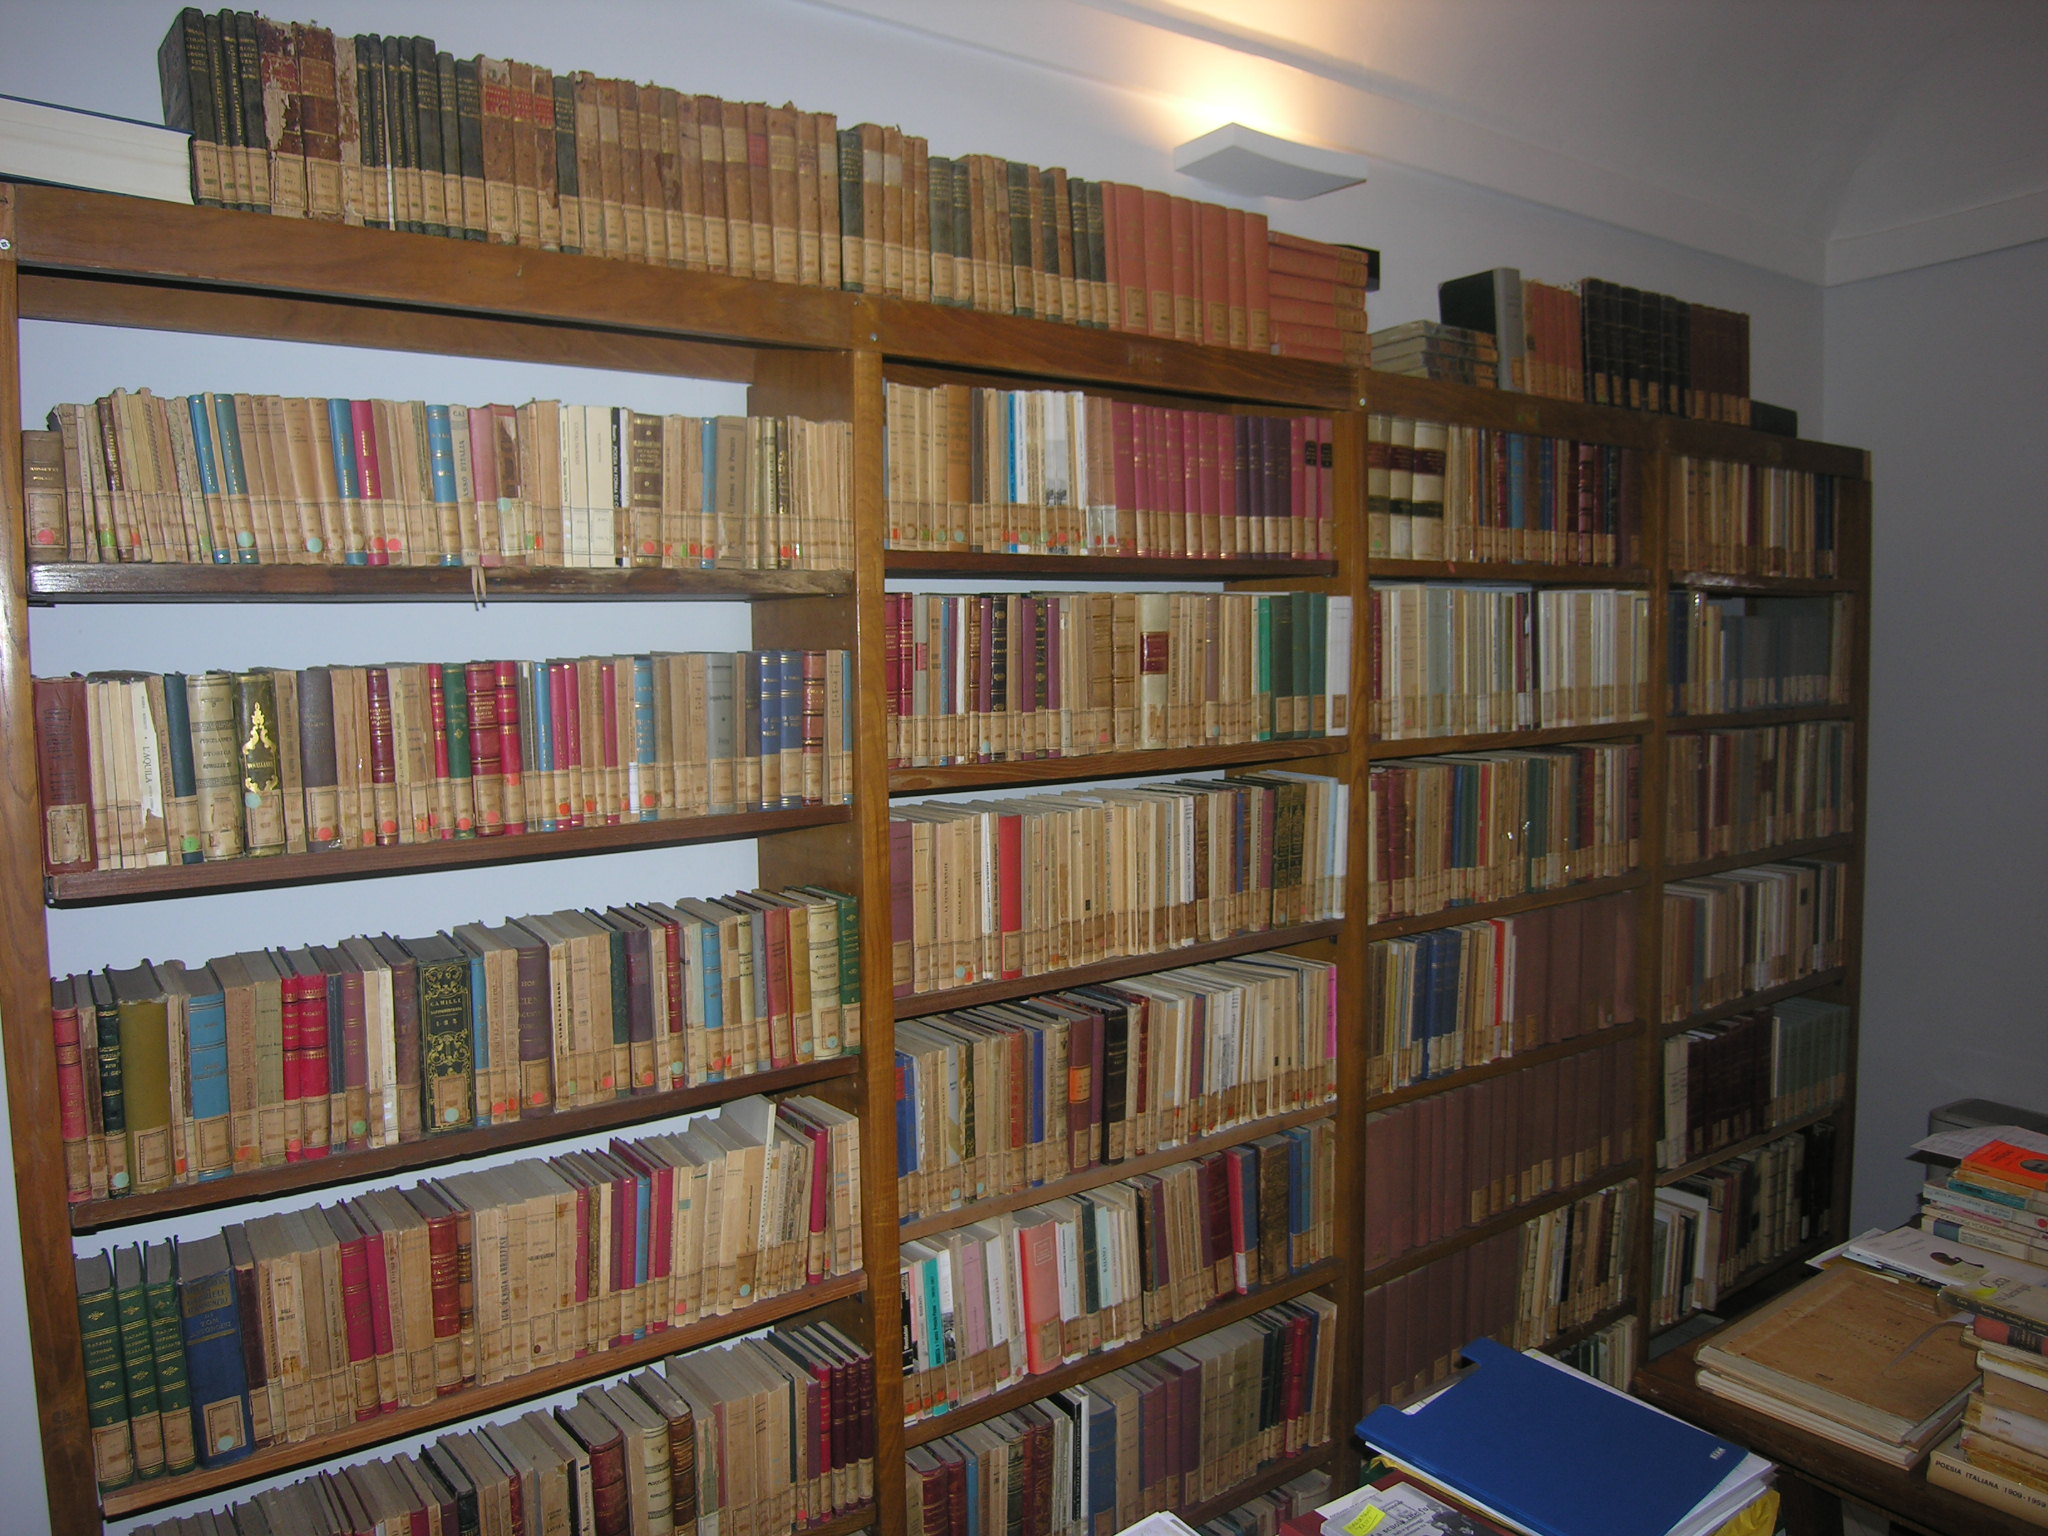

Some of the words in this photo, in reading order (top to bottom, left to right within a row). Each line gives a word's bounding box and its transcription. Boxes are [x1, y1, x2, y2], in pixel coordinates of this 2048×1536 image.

[143, 746, 154, 784] L'AQUILA
[1935, 1459, 1962, 1475] POESIA
[1965, 1472, 1999, 1489] ITALIANA
